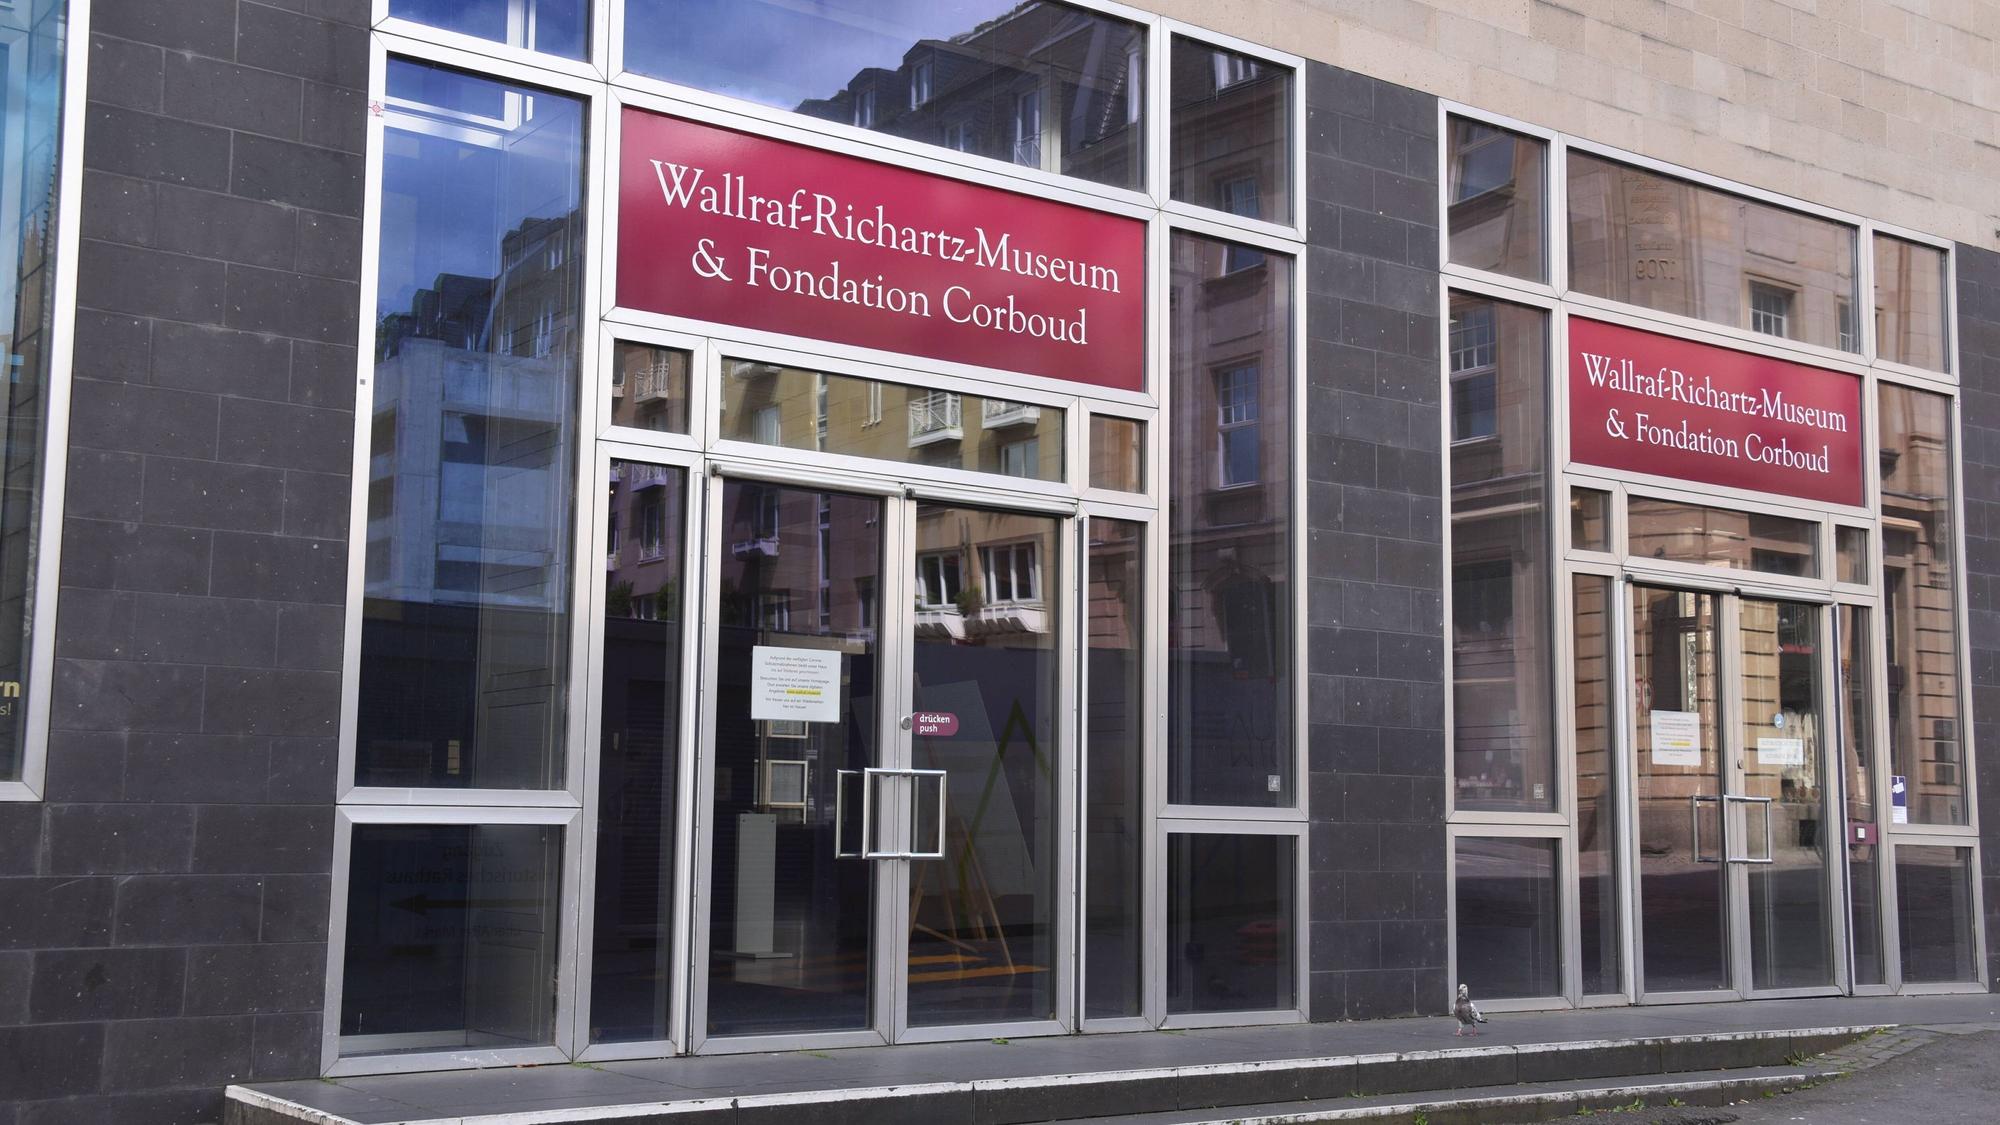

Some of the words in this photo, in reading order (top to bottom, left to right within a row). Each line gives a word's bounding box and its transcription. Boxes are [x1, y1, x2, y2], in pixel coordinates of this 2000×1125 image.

[649, 158, 1121, 295] Wallraf-Richartz-Museum
[691, 237, 733, 282] &
[746, 245, 932, 317] Fondation
[942, 284, 1089, 346] Corboud
[1581, 352, 1848, 433] Wallraf-Richartz-Museum
[1606, 408, 1629, 440] &
[1635, 412, 1739, 459] Fondation
[1744, 433, 1830, 474] Corboud
[919, 713, 951, 724] drücken
[919, 723, 938, 735] push
